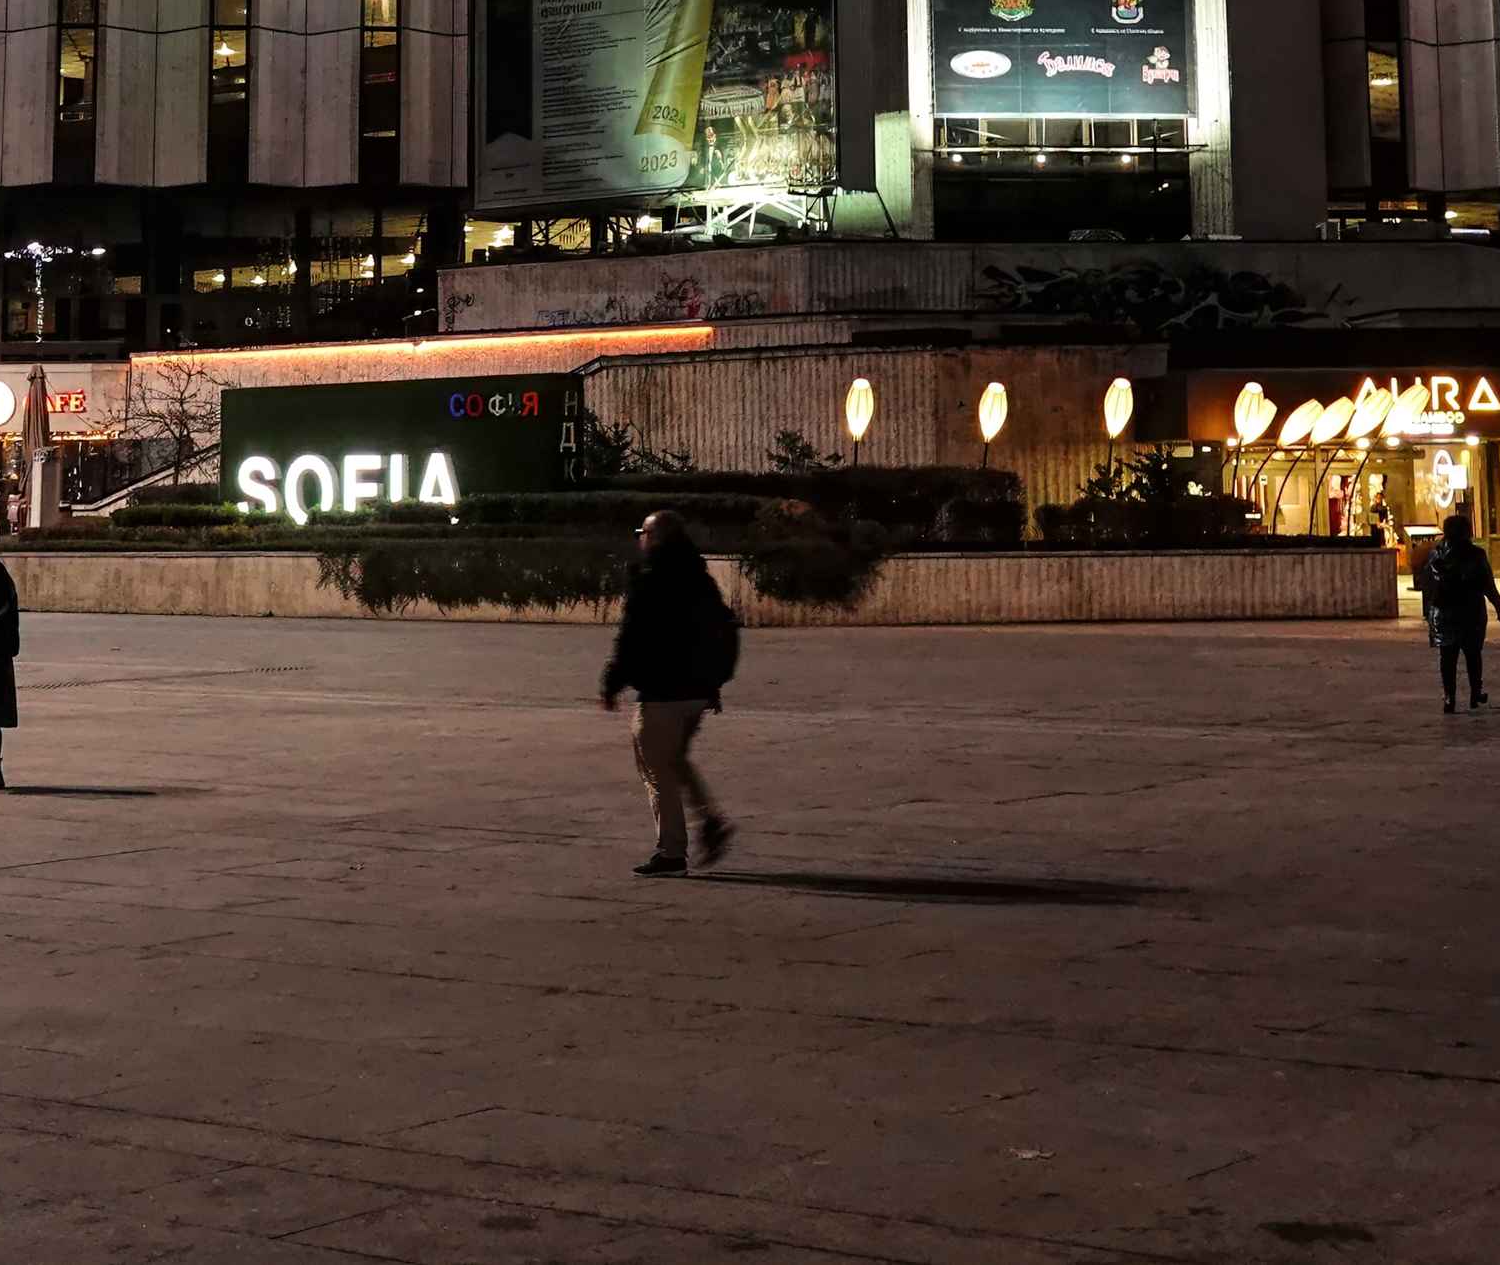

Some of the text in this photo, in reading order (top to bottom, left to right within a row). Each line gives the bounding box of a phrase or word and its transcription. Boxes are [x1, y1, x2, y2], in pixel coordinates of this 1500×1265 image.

[652, 105, 686, 129] 2024
[637, 150, 678, 173] 2023
[23, 389, 86, 414] AFÉ
[237, 452, 461, 525] SOFIA
